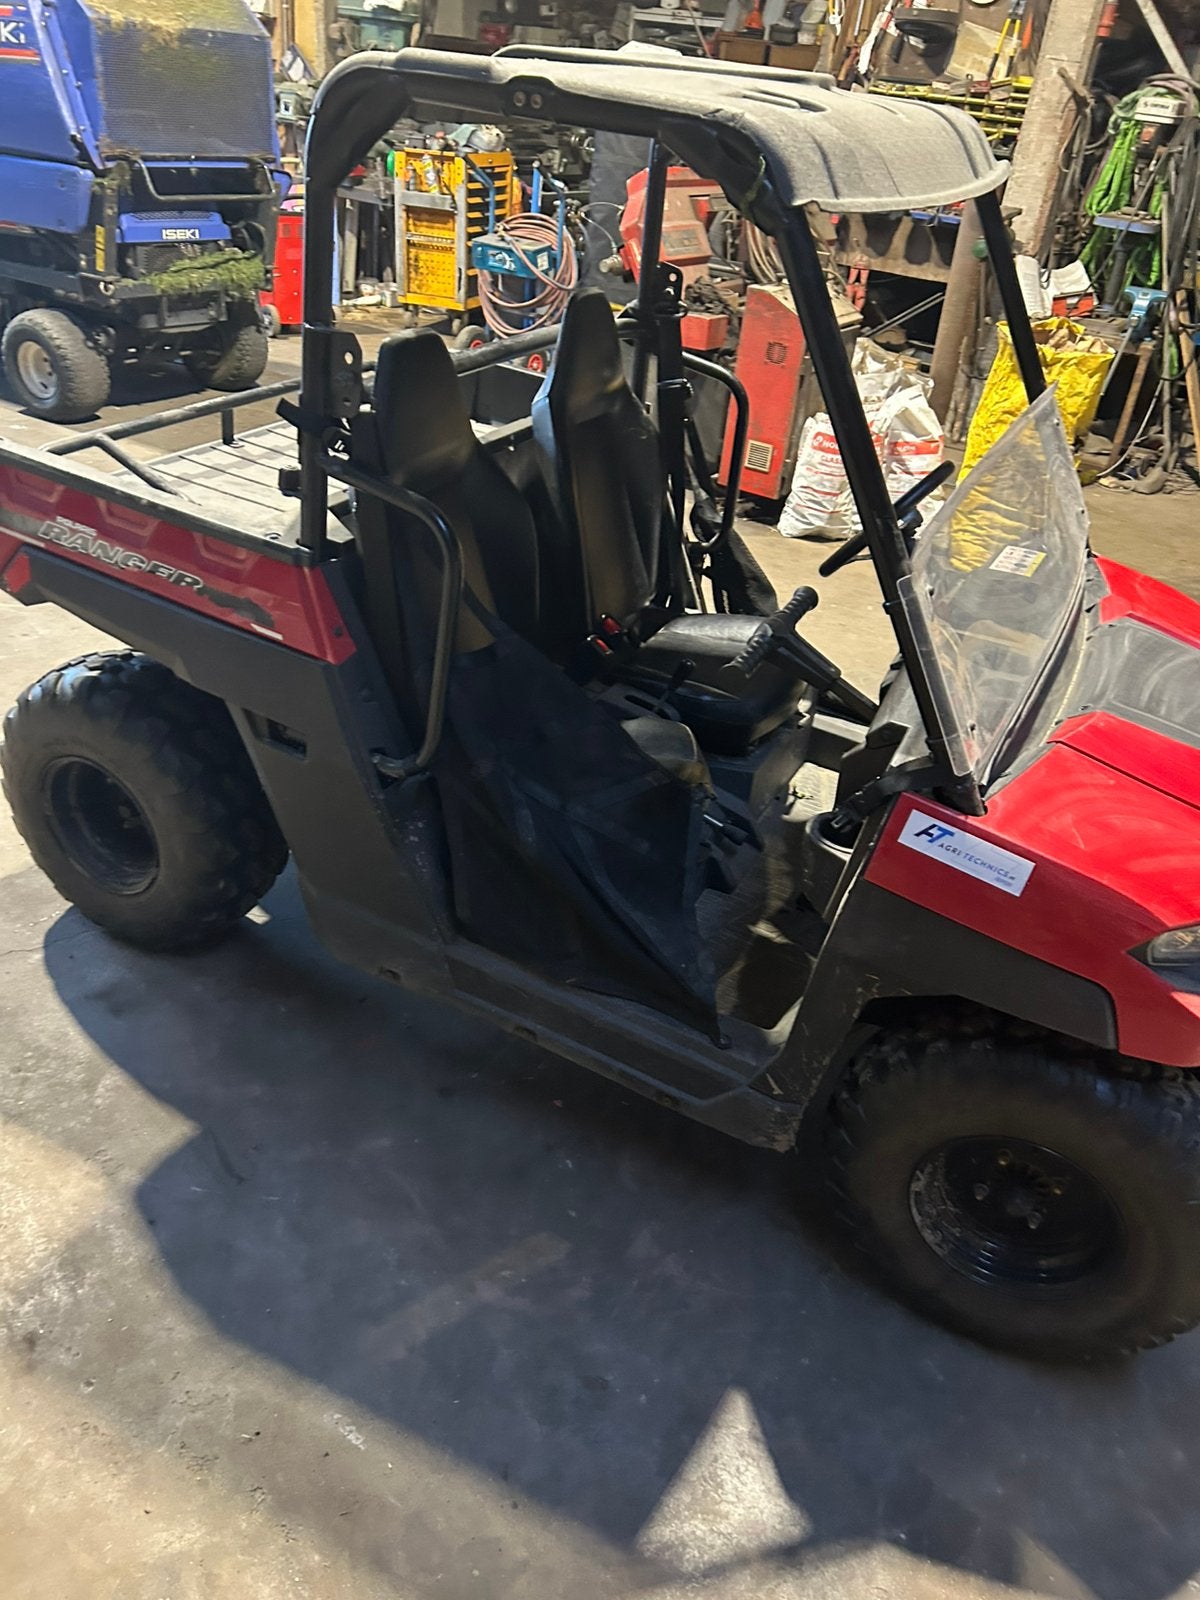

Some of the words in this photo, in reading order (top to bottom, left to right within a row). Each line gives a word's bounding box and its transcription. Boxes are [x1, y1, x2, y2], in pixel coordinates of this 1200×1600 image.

[162, 229, 199, 240] ISEKI
[37, 521, 203, 591] RANGER
[938, 843, 962, 856] AGRI
[963, 853, 1009, 878] TECHNICS
